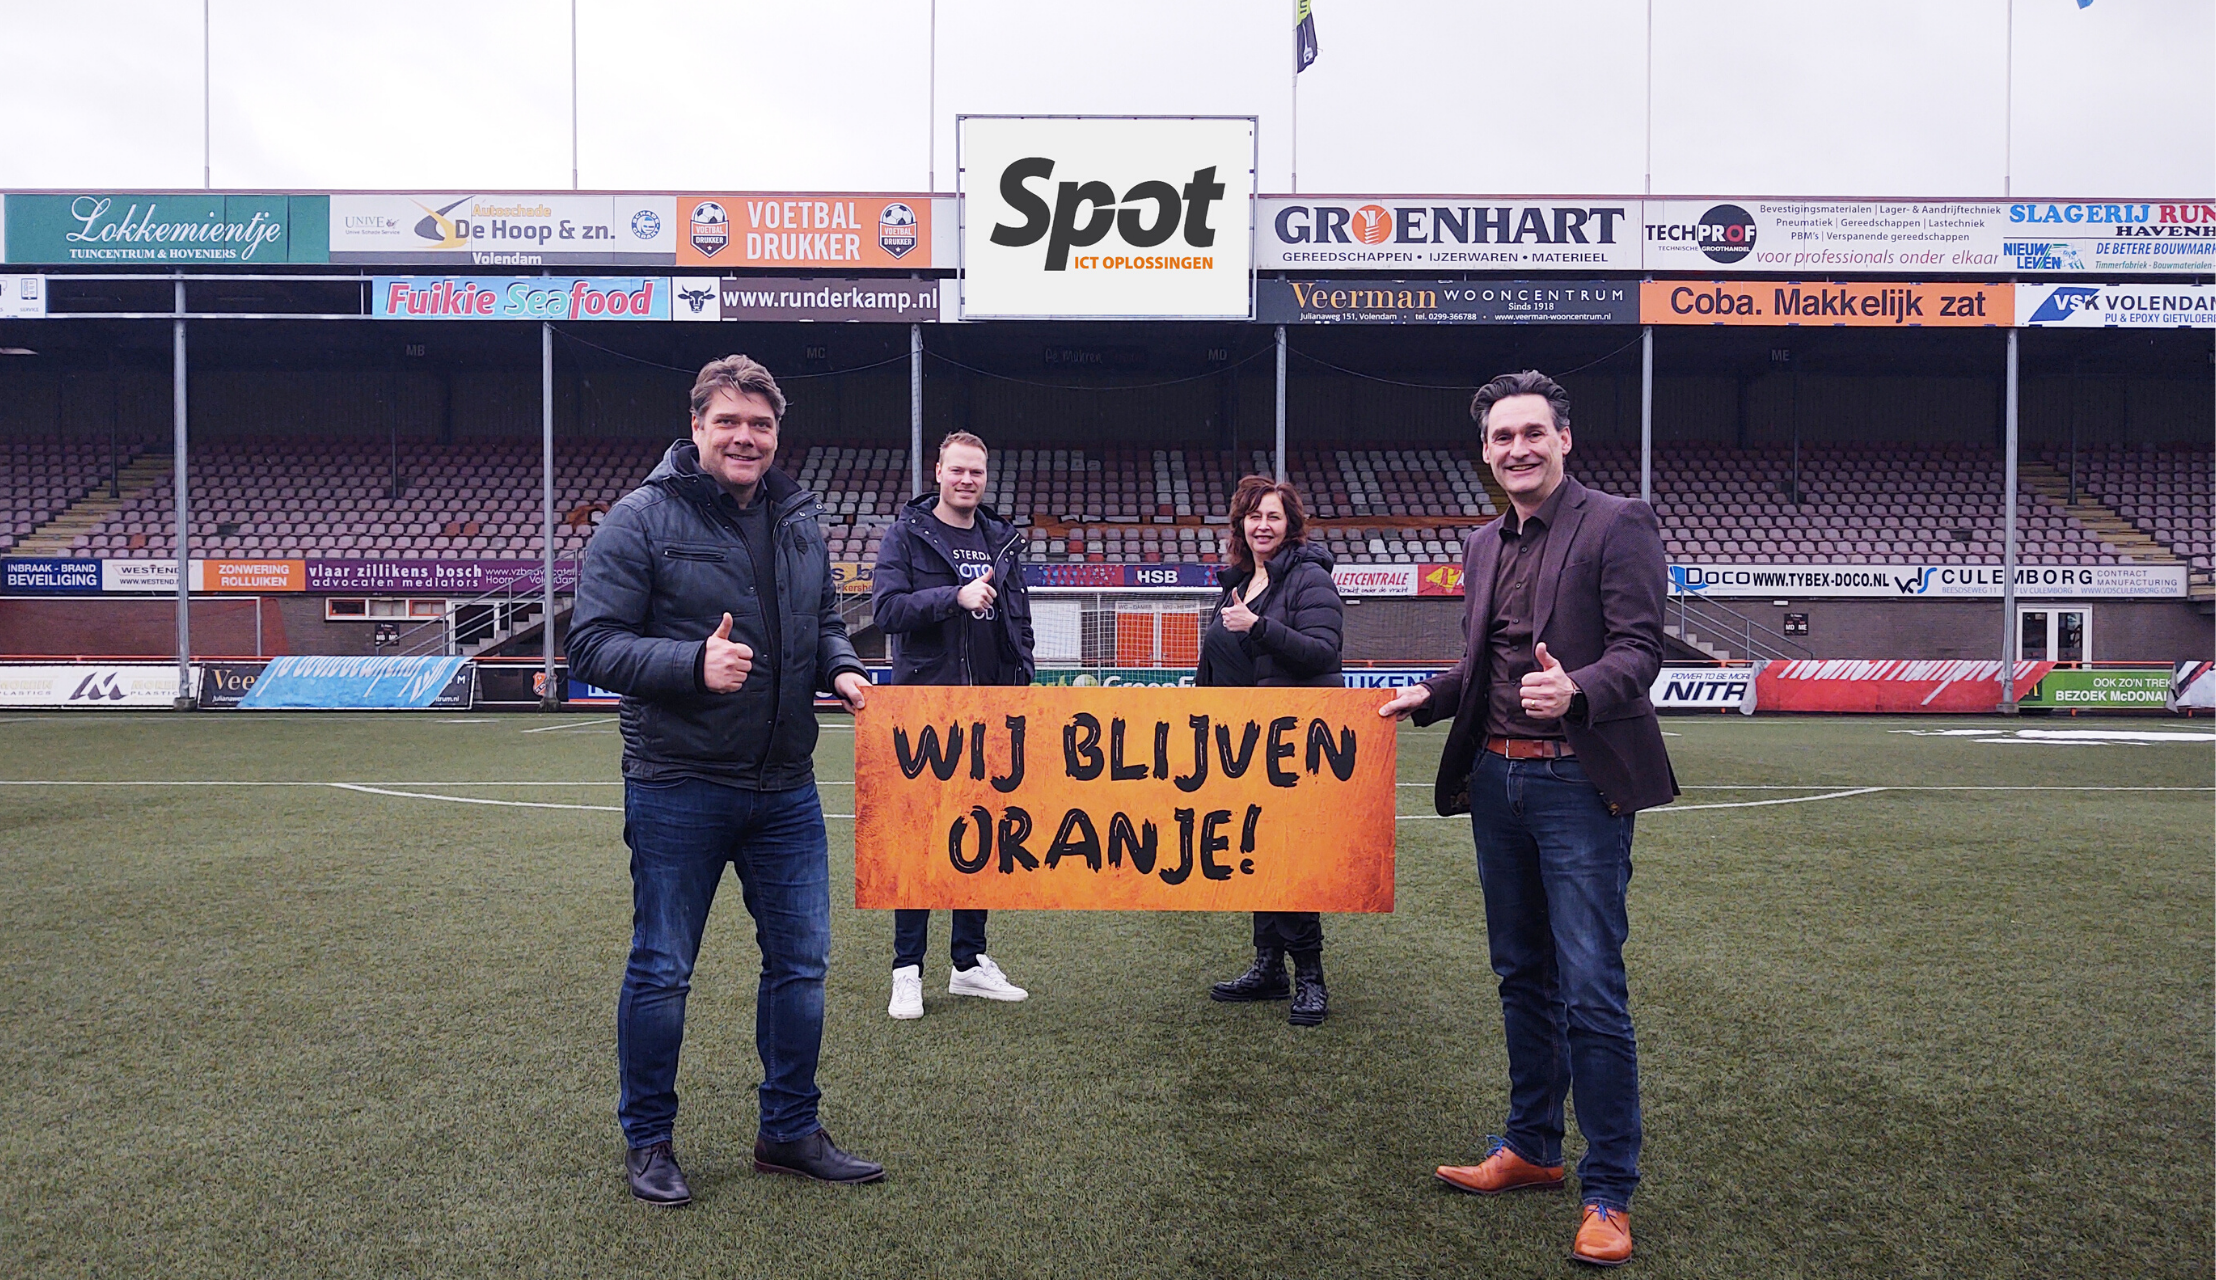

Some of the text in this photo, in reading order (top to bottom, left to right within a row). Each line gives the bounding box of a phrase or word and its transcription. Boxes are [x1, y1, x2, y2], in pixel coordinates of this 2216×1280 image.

[472, 204, 552, 217] Autoschade
[747, 201, 861, 229] VOETBAL
[990, 157, 1226, 271] Spot
[1760, 204, 2001, 217] Bevestigingsmaterialen Lager- & Aandrijftechniek
[2009, 204, 2151, 224] SLAGERIJ
[66, 196, 281, 261] Lokkemientje
[695, 225, 724, 234] VOETBAL
[1274, 204, 1625, 245] GROENHART
[1776, 218, 1985, 229] Pneumatiek Gereedschappen Lastechniek
[455, 219, 616, 246] De Hoop & zn.
[884, 226, 912, 235] VOETBAL
[1645, 223, 1757, 242] TECHPROF
[695, 236, 724, 245] DRUKKER
[884, 237, 912, 246] DRUKKER
[1826, 232, 1889, 243] Verspanende
[1891, 232, 1970, 243] gereedschappen
[747, 233, 861, 260] DRUKKER
[2003, 243, 2051, 256] NIEUW
[2096, 243, 2112, 255] DE
[2113, 243, 2152, 255] BETERE
[69, 248, 236, 259] TUINCENTRUM & HOVENIERS
[472, 252, 542, 265] Volendam
[1282, 252, 1608, 262] GEREEDSCHAPPEN IJZERWAREN MATERIEEL
[1756, 249, 1999, 267] voor professionals onder elkaar
[1074, 256, 1214, 269] ICT OPLOSSINGEN
[2017, 256, 2062, 269] LEVEN
[2095, 261, 2148, 269] Timmerfabriek
[2153, 261, 2212, 269] Bouwmaterialen
[385, 279, 654, 320] Fuikie Seafood
[722, 287, 938, 313] www.runderkamp.nl
[1289, 282, 1438, 309] Veerman
[1444, 289, 1625, 301] WOONCENTRUM
[1508, 302, 1555, 311] Sinds 1918
[1671, 287, 1987, 323] Coba. Makkelijk zat
[2053, 294, 2100, 310] VSK
[1299, 312, 1612, 322] Julianaweg 151, Volendam tel. 0299-366788 www.veerman-wooncentrum.nl
[2105, 313, 2119, 323] PU
[2130, 314, 2160, 323] EPOXY
[2163, 314, 2216, 323] GIETVLOER
[7, 564, 52, 573] INBRAAK
[61, 564, 96, 573] BRAND
[218, 565, 290, 574] ZONWERING
[309, 564, 482, 577] vlaar zillikens bosch
[7, 574, 97, 586] BEVEILIGING
[221, 577, 287, 586] ROLLUIKEN
[312, 577, 479, 587] advocaten mediators
[486, 576, 514, 584] Hoorn
[1137, 570, 1178, 583] HSB
[1753, 572, 1889, 587] WWW.TYBEX-DOCO.NL
[2093, 678, 2117, 688] OOK
[2118, 678, 2143, 688] ZO'N
[2056, 691, 2107, 702] BEZOEK
[893, 712, 1357, 793] WIJ BLIJVEN
[949, 803, 1262, 885] ORANJE!
